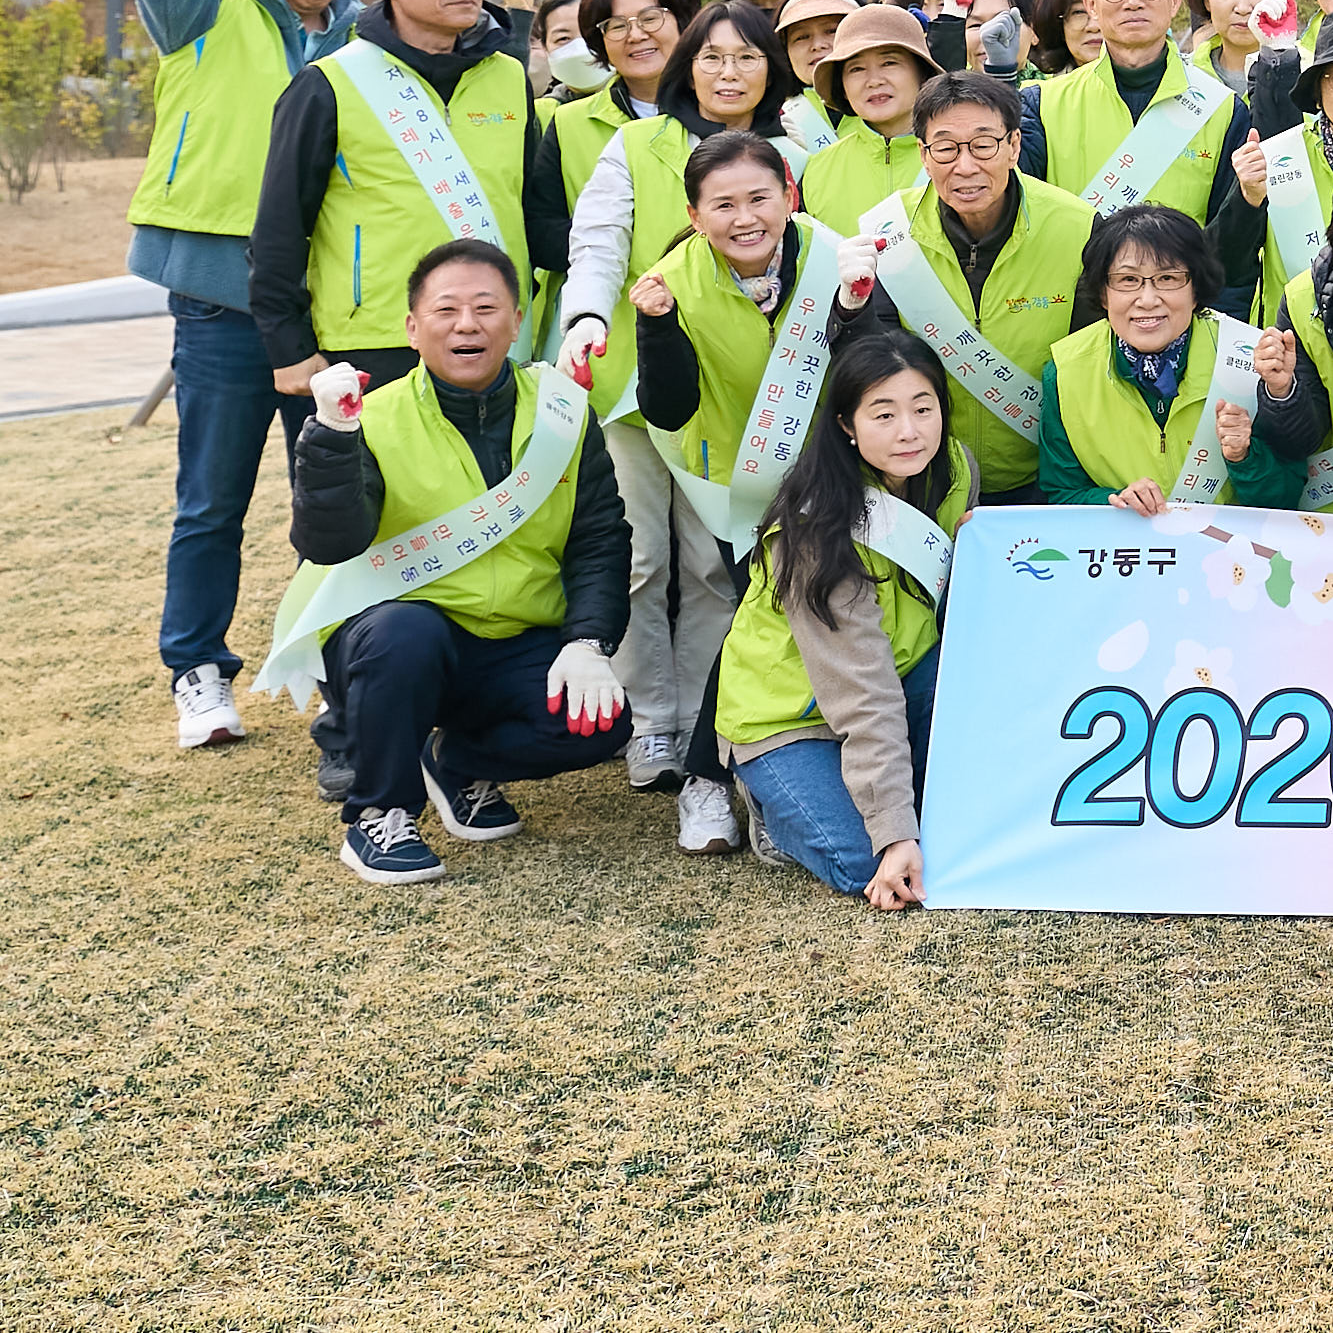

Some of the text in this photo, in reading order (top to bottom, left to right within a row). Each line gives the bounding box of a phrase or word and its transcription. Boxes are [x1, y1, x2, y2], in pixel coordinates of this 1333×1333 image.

[387, 108, 433, 166] 쓰레기
[1268, 170, 1303, 186] 클린강동
[741, 297, 816, 475] 우리가 만들어요
[922, 323, 1040, 430] 우리가 만들어
[956, 332, 1015, 383] 깨끗한
[774, 416, 802, 462] 강동
[369, 471, 530, 572] 우리가 만들어요
[401, 504, 528, 584] 깨끗한 강동
[1079, 547, 1176, 578] 강동구
